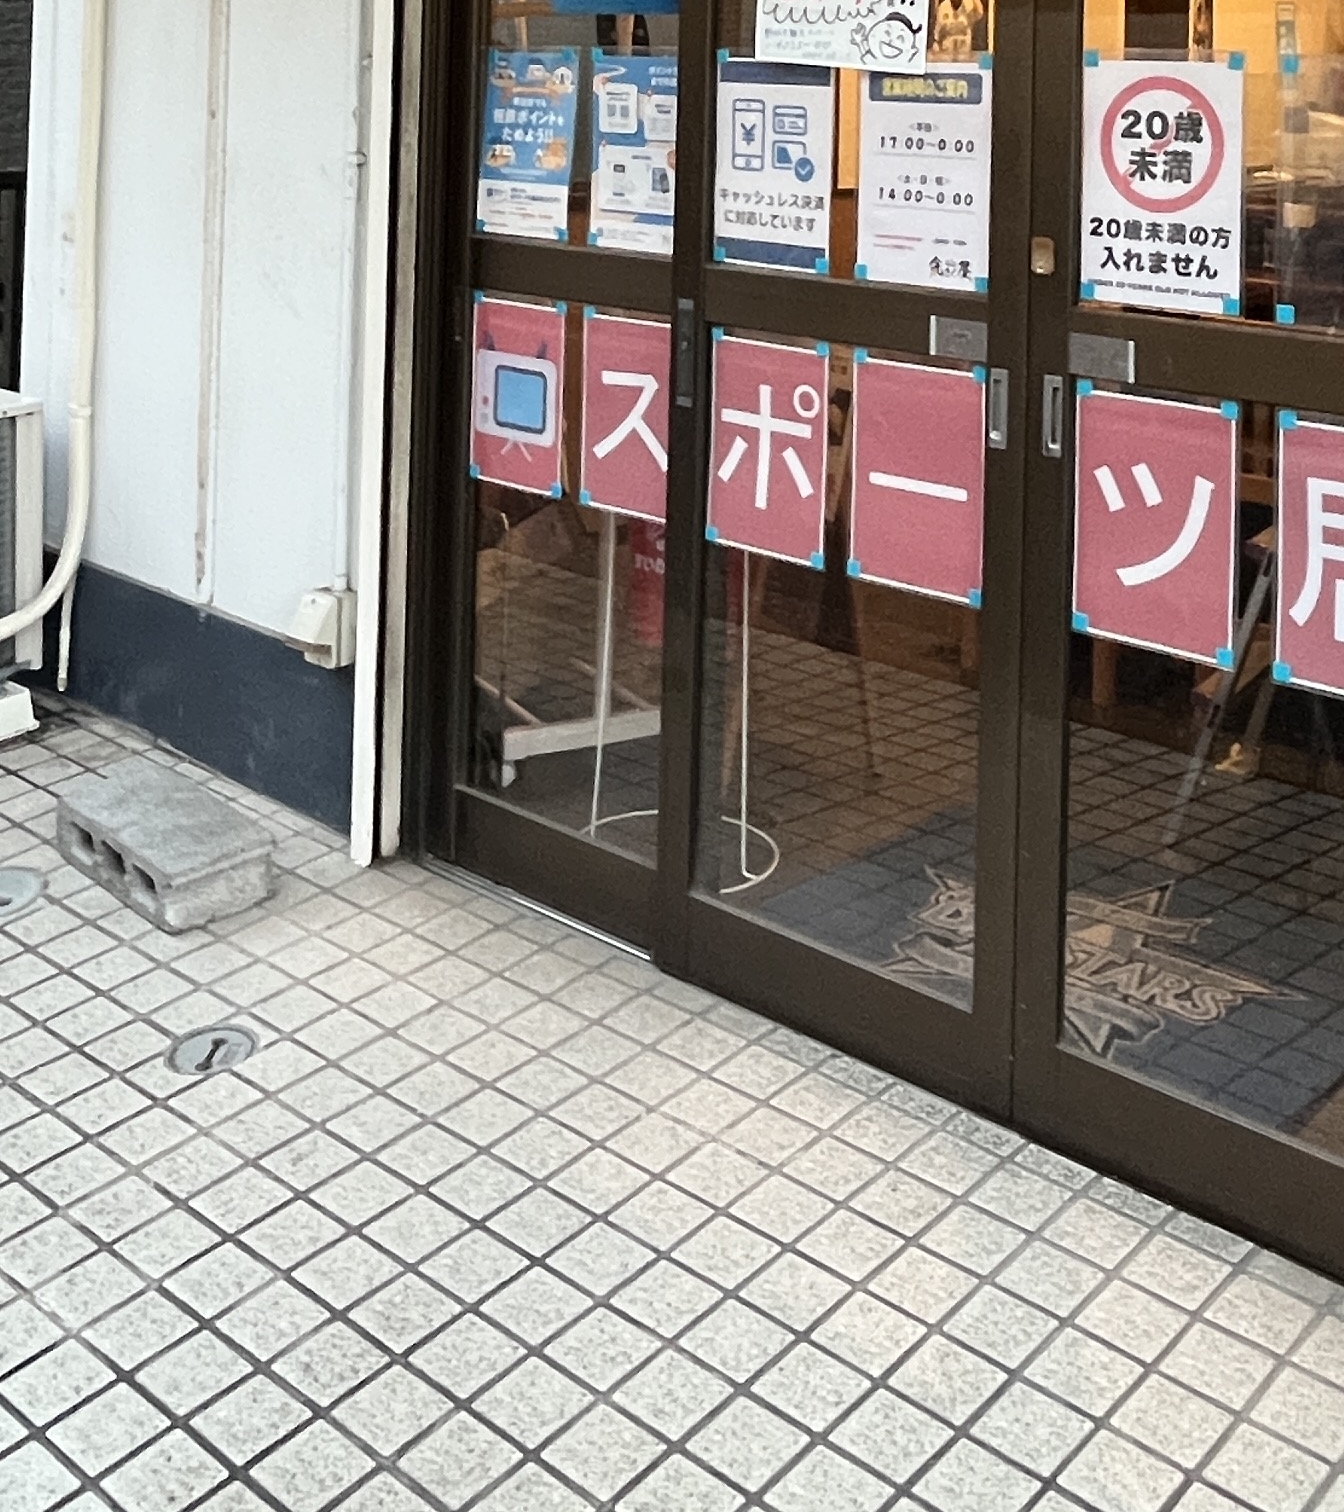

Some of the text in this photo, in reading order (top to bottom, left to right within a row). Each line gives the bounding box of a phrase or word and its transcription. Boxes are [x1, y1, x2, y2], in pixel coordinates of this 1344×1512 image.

[1119, 109, 1205, 144] 20歳
[1127, 146, 1194, 185] 未満
[1088, 216, 1233, 250] 20歳未満の方
[1099, 245, 1219, 280] 入れません
